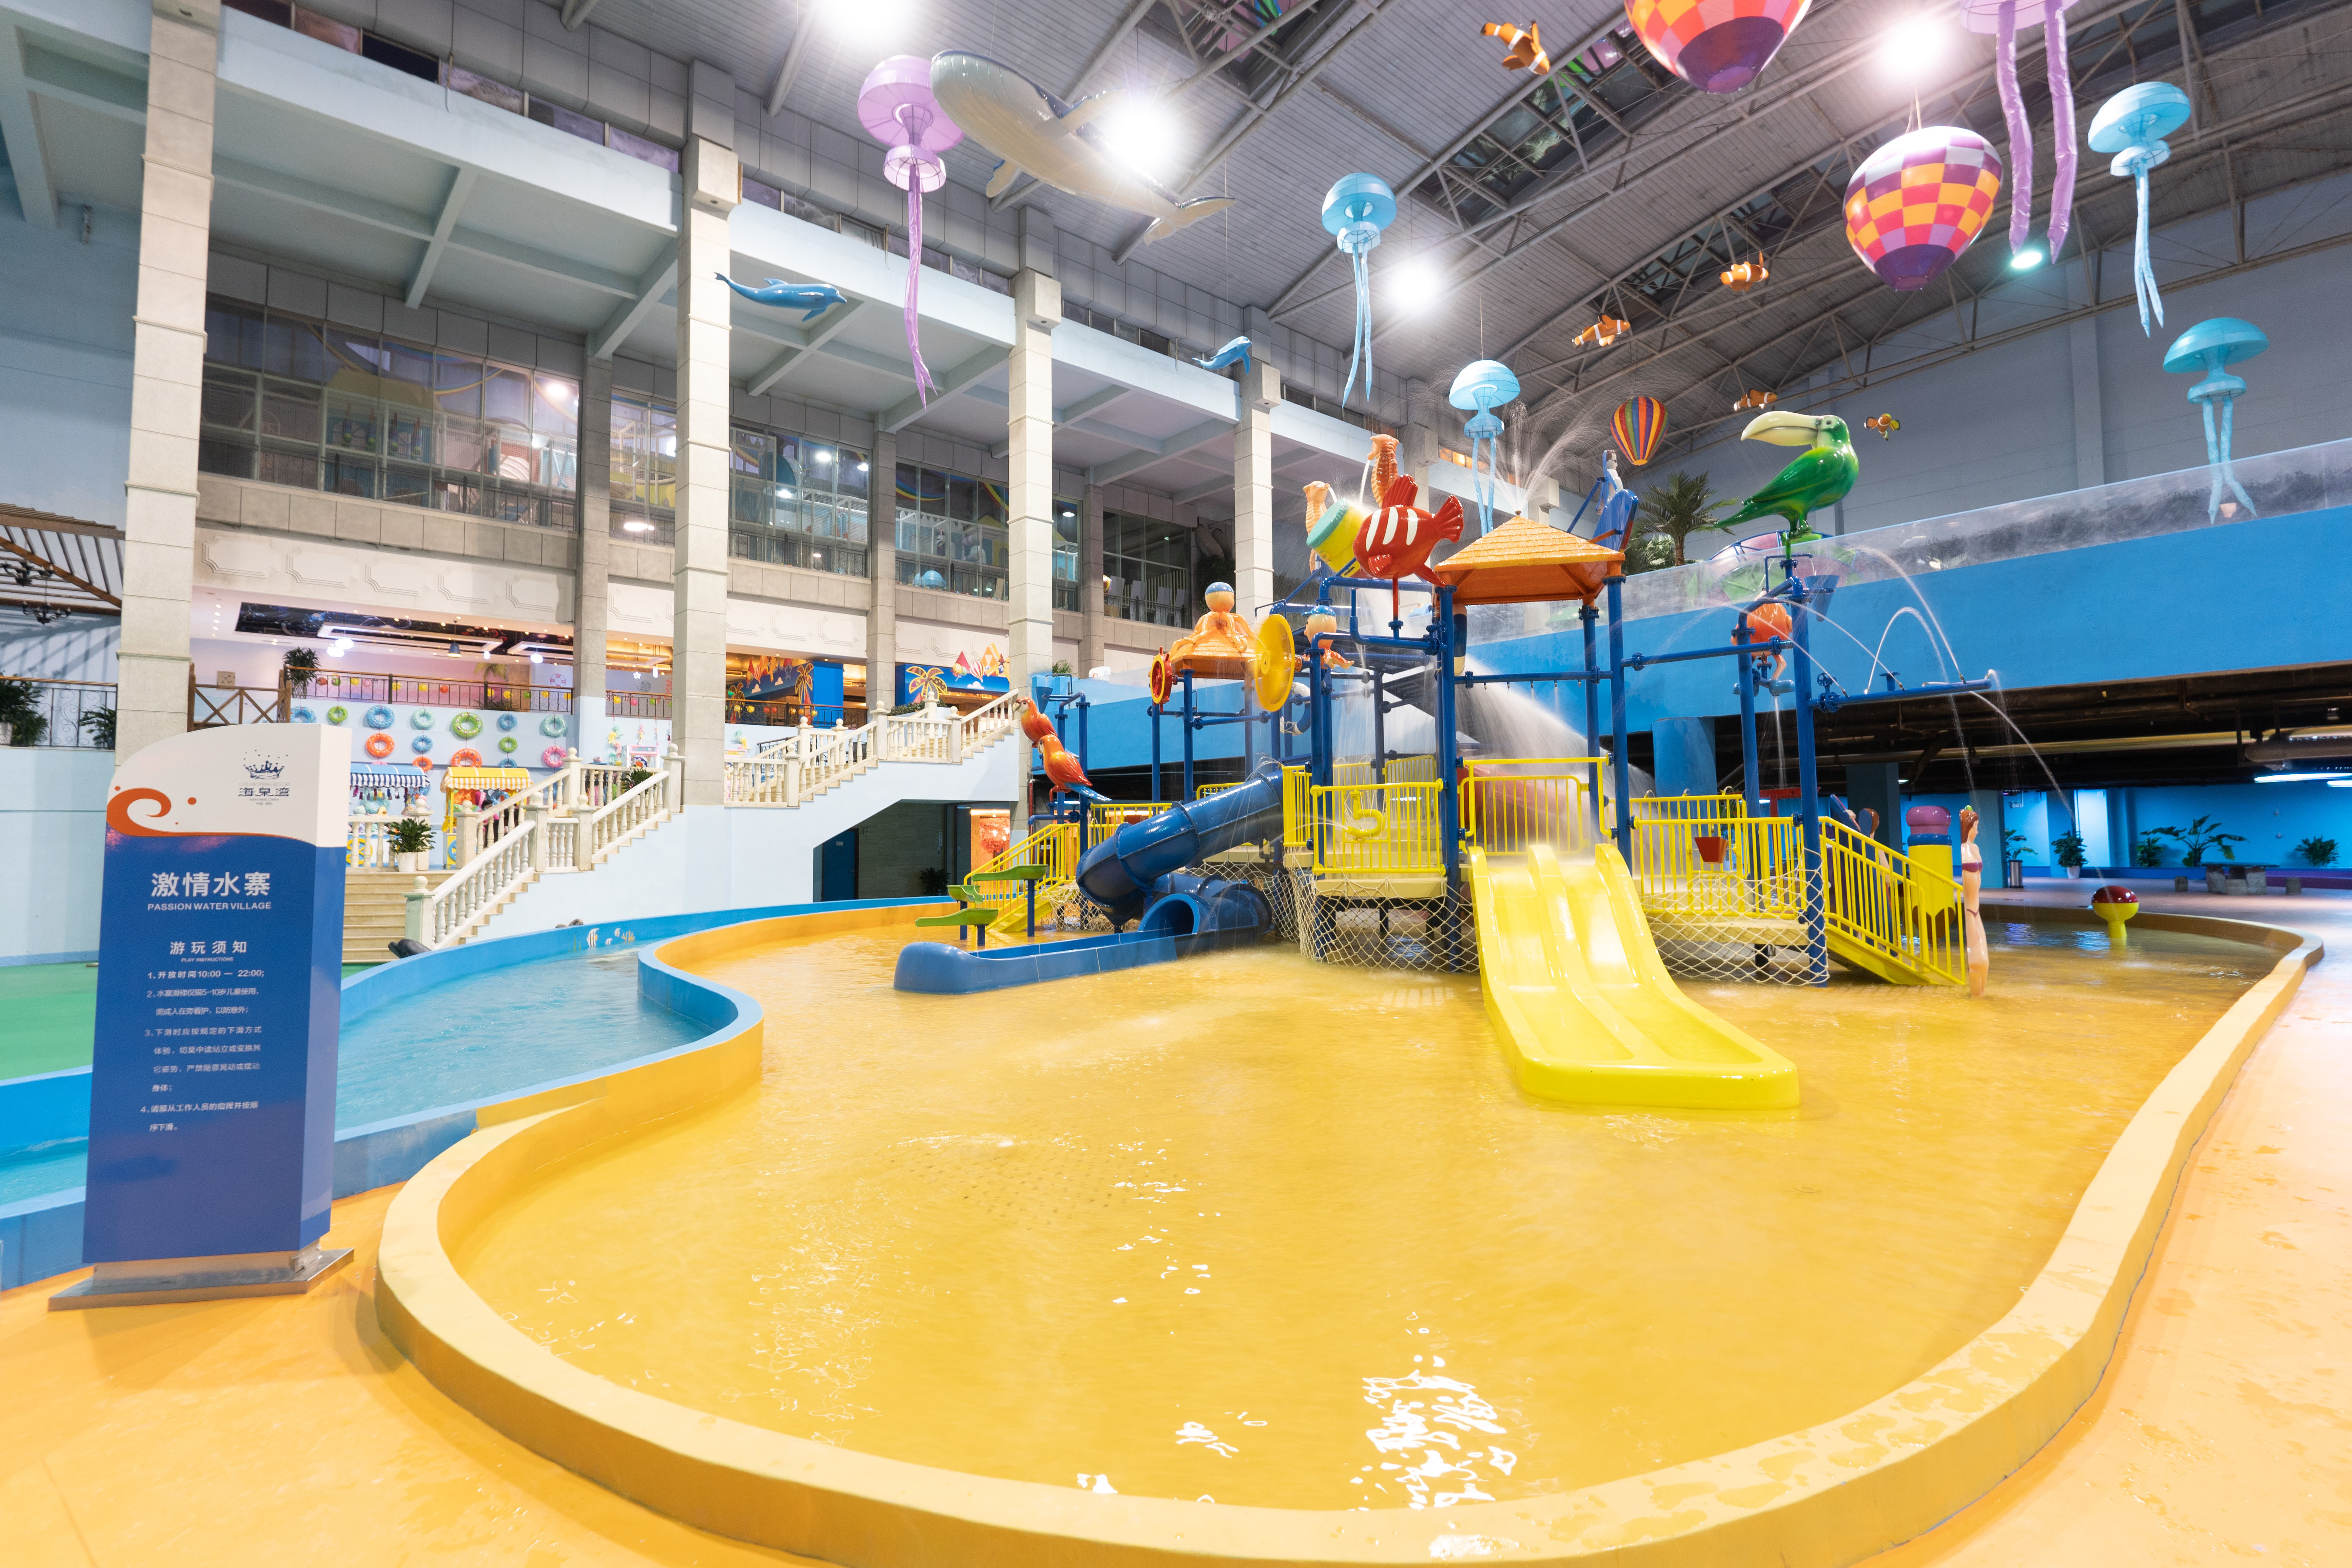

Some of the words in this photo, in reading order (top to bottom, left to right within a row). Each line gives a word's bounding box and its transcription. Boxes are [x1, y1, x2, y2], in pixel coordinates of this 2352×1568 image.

[238, 787, 290, 797] 海泉湾
[151, 871, 270, 897] 激情水寨
[169, 940, 247, 955] 游玩须知
